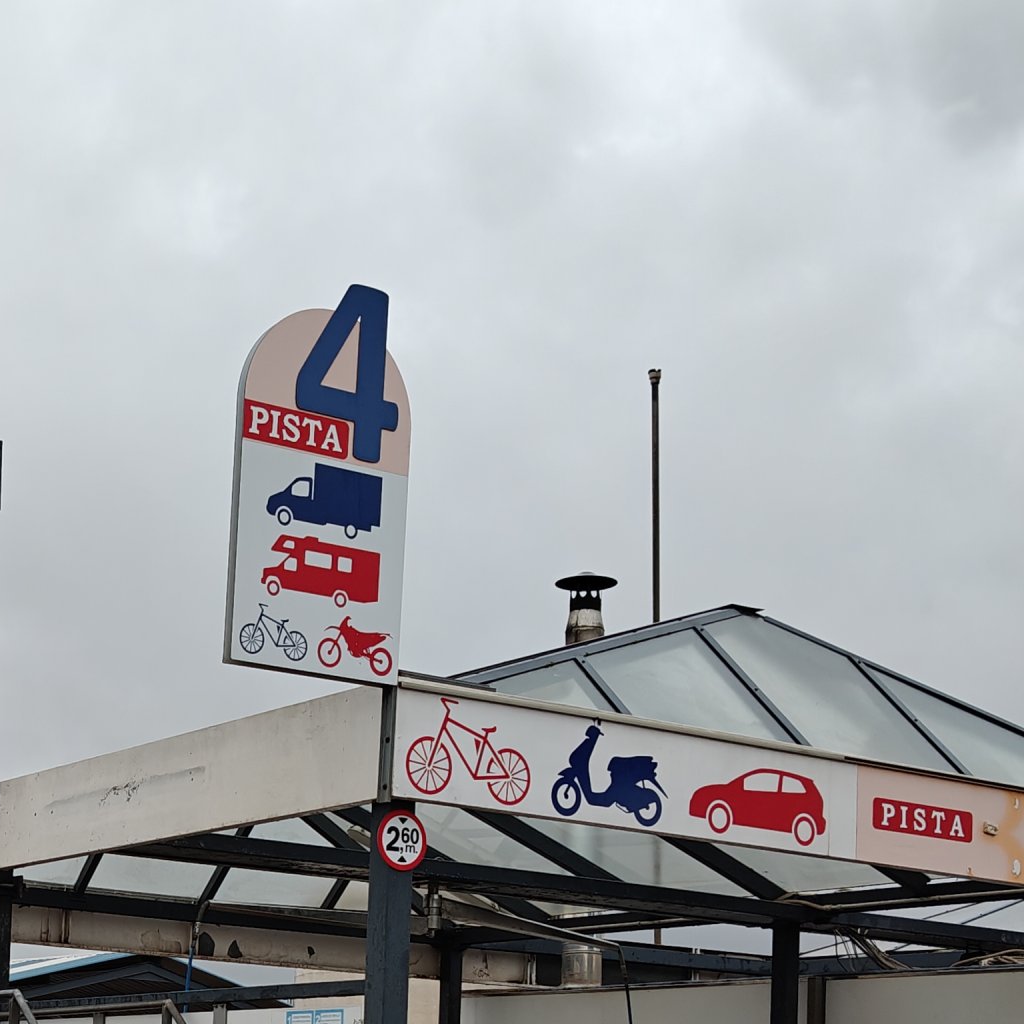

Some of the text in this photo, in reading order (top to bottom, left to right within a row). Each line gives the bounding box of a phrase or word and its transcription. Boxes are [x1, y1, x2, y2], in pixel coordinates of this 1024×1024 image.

[296, 284, 398, 463] 4
[249, 405, 342, 453] PISTA
[880, 803, 965, 838] PISTA
